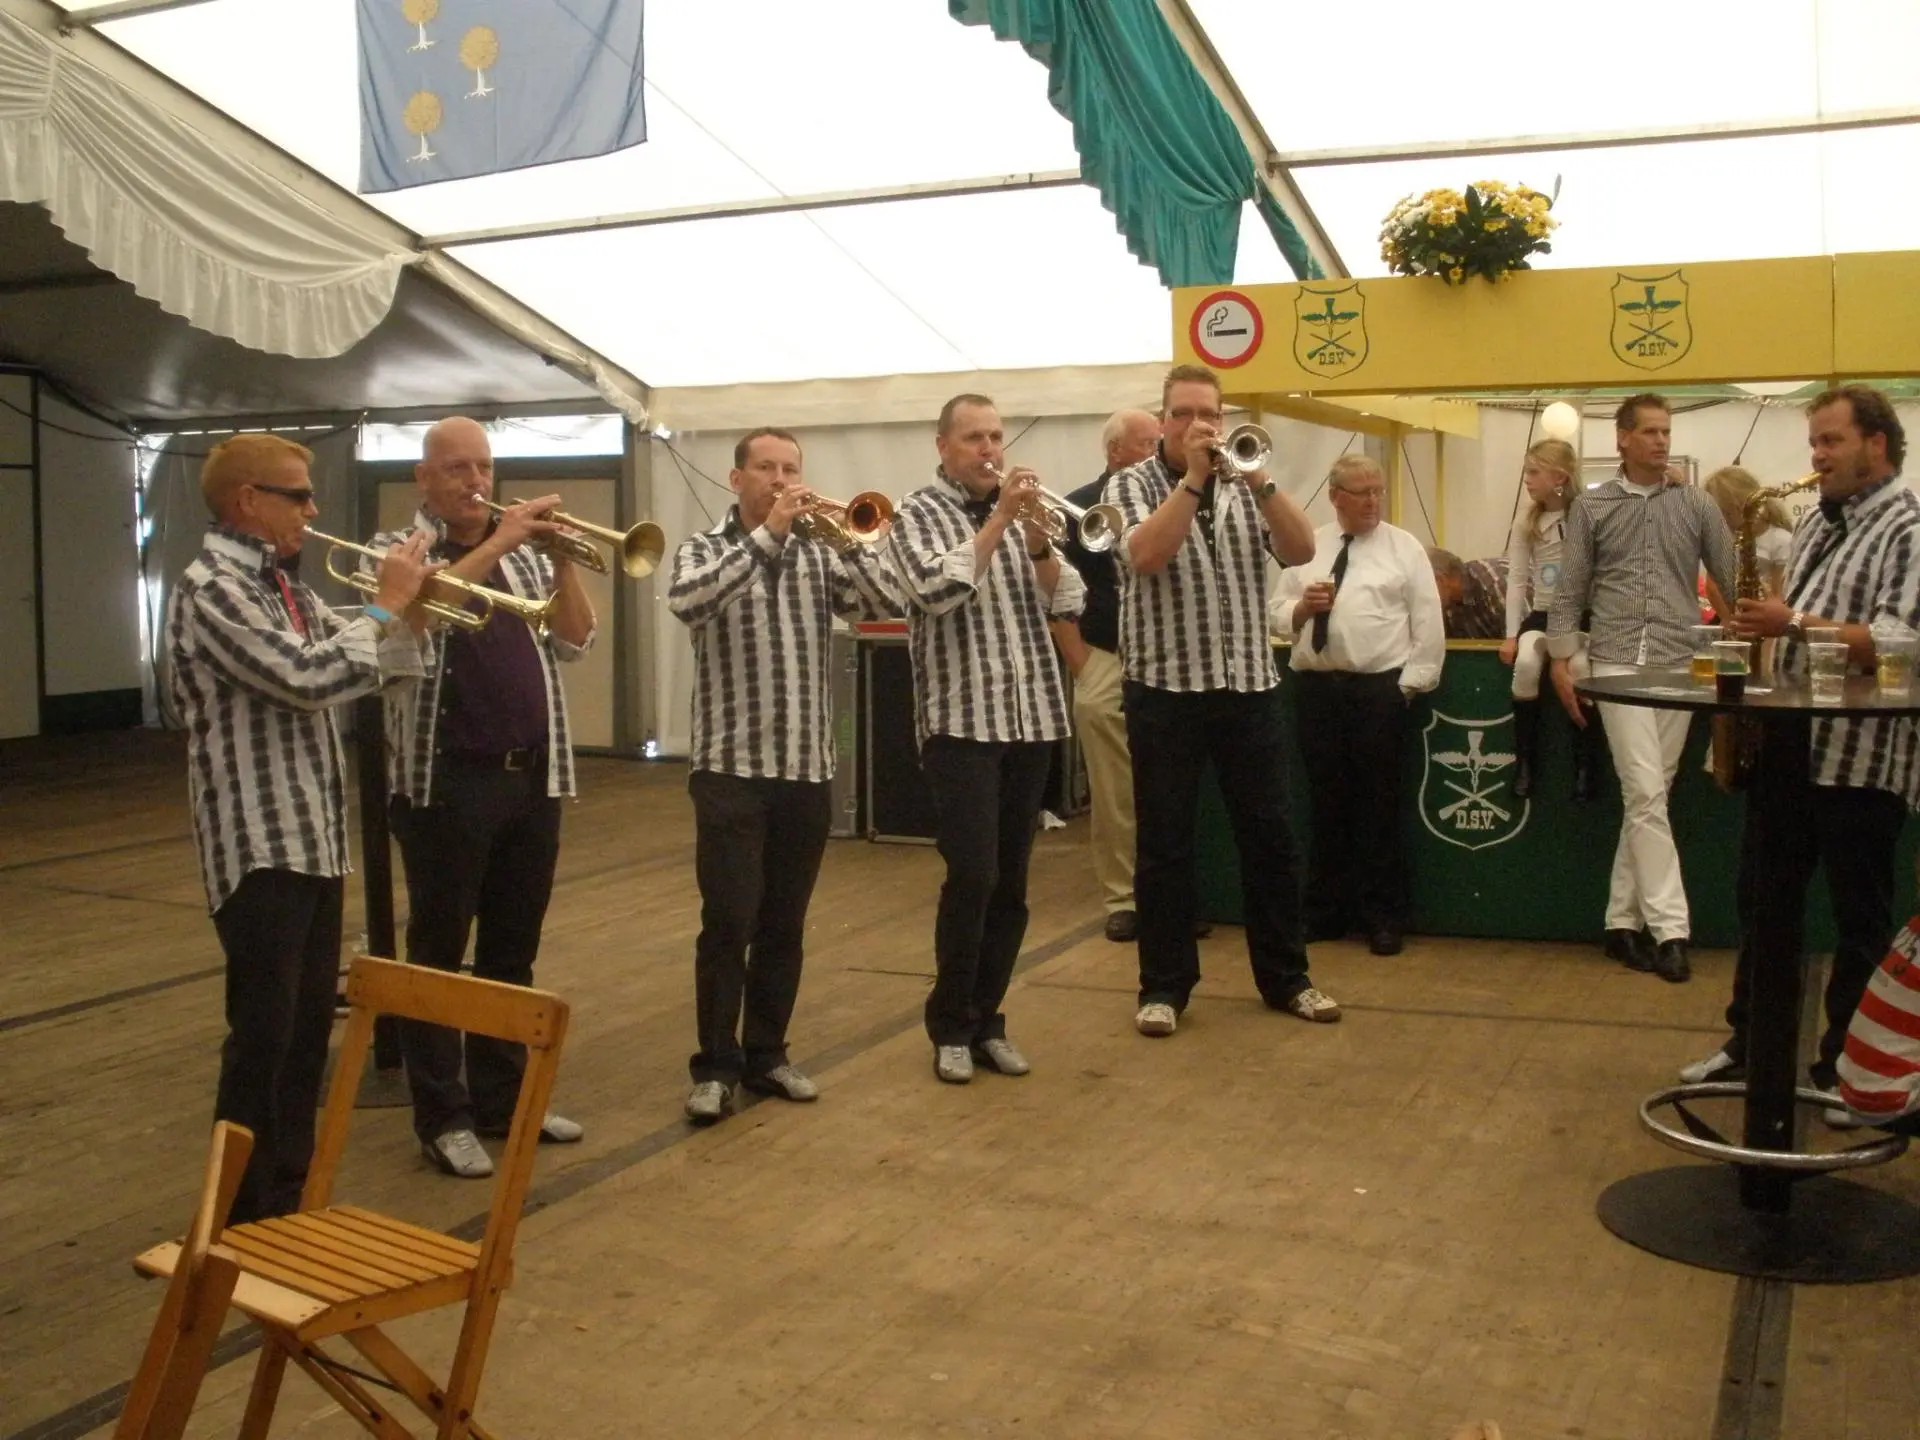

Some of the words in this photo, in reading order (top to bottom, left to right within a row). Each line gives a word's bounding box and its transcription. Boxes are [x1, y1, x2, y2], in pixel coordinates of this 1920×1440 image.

[1638, 342, 1667, 357] D.S.V.
[1319, 352, 1346, 366] D.S.V.
[1455, 809, 1495, 829] D.S.V.
